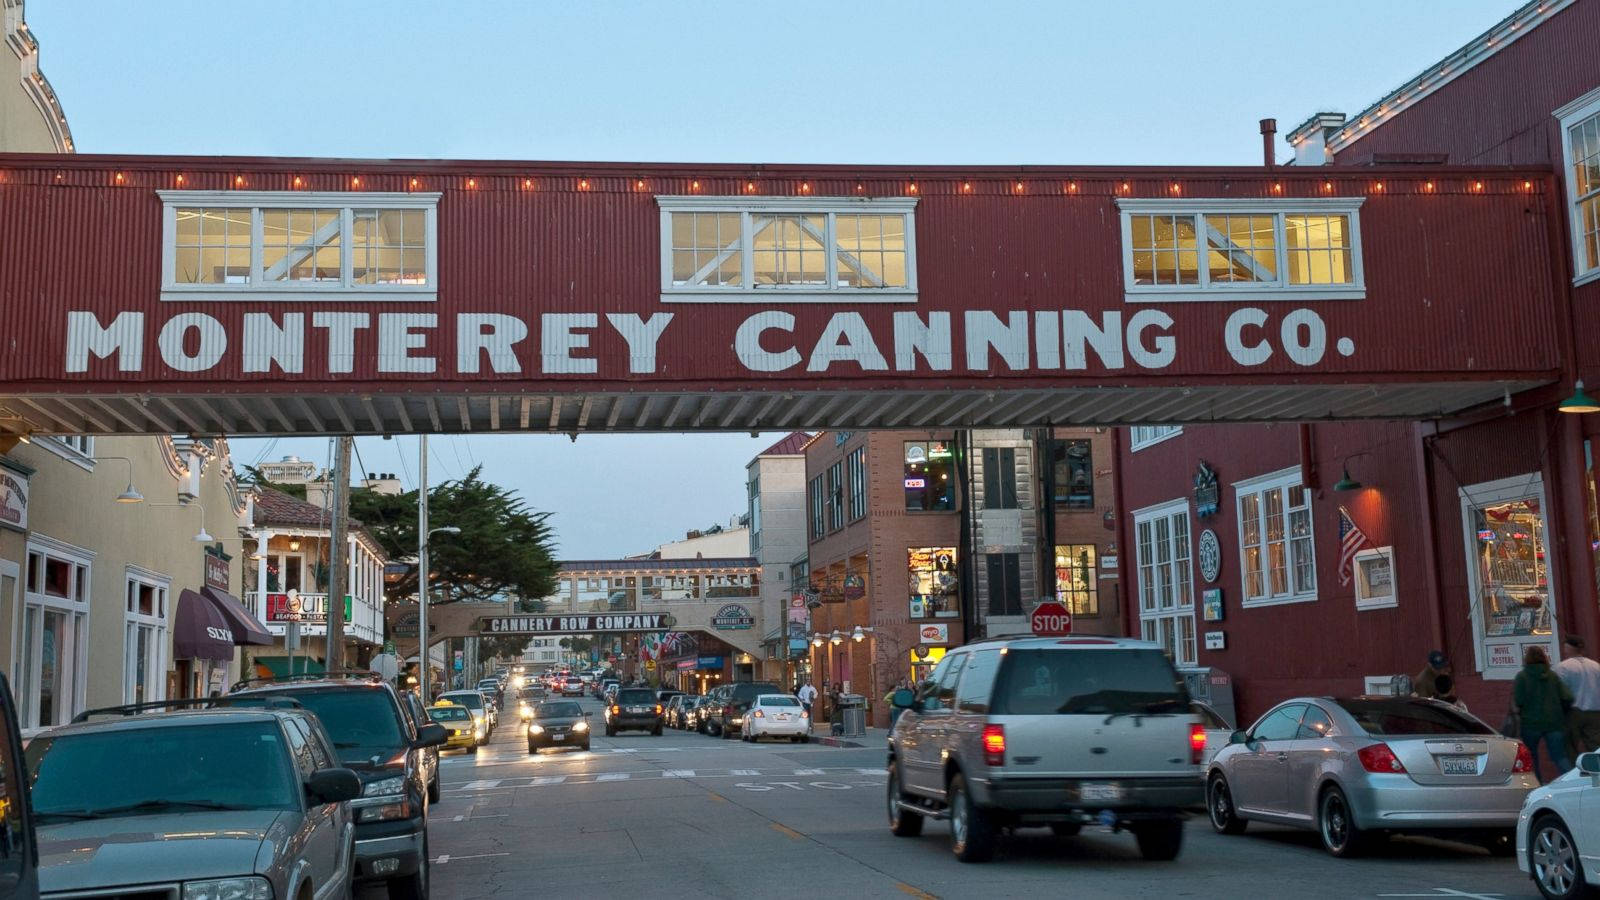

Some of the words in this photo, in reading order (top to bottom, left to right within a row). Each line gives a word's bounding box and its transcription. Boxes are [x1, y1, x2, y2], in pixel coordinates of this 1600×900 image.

[65, 310, 675, 375] MONTEREY
[734, 309, 1177, 373] CANNING
[1224, 307, 1355, 367] CO.
[491, 616, 553, 632] CANNERY
[560, 616, 589, 631] ROW
[595, 614, 660, 629] COMPANY
[1033, 615, 1070, 632] STOP
[1494, 646, 1510, 655] MOVIE
[1491, 656, 1515, 665] POSTERS
